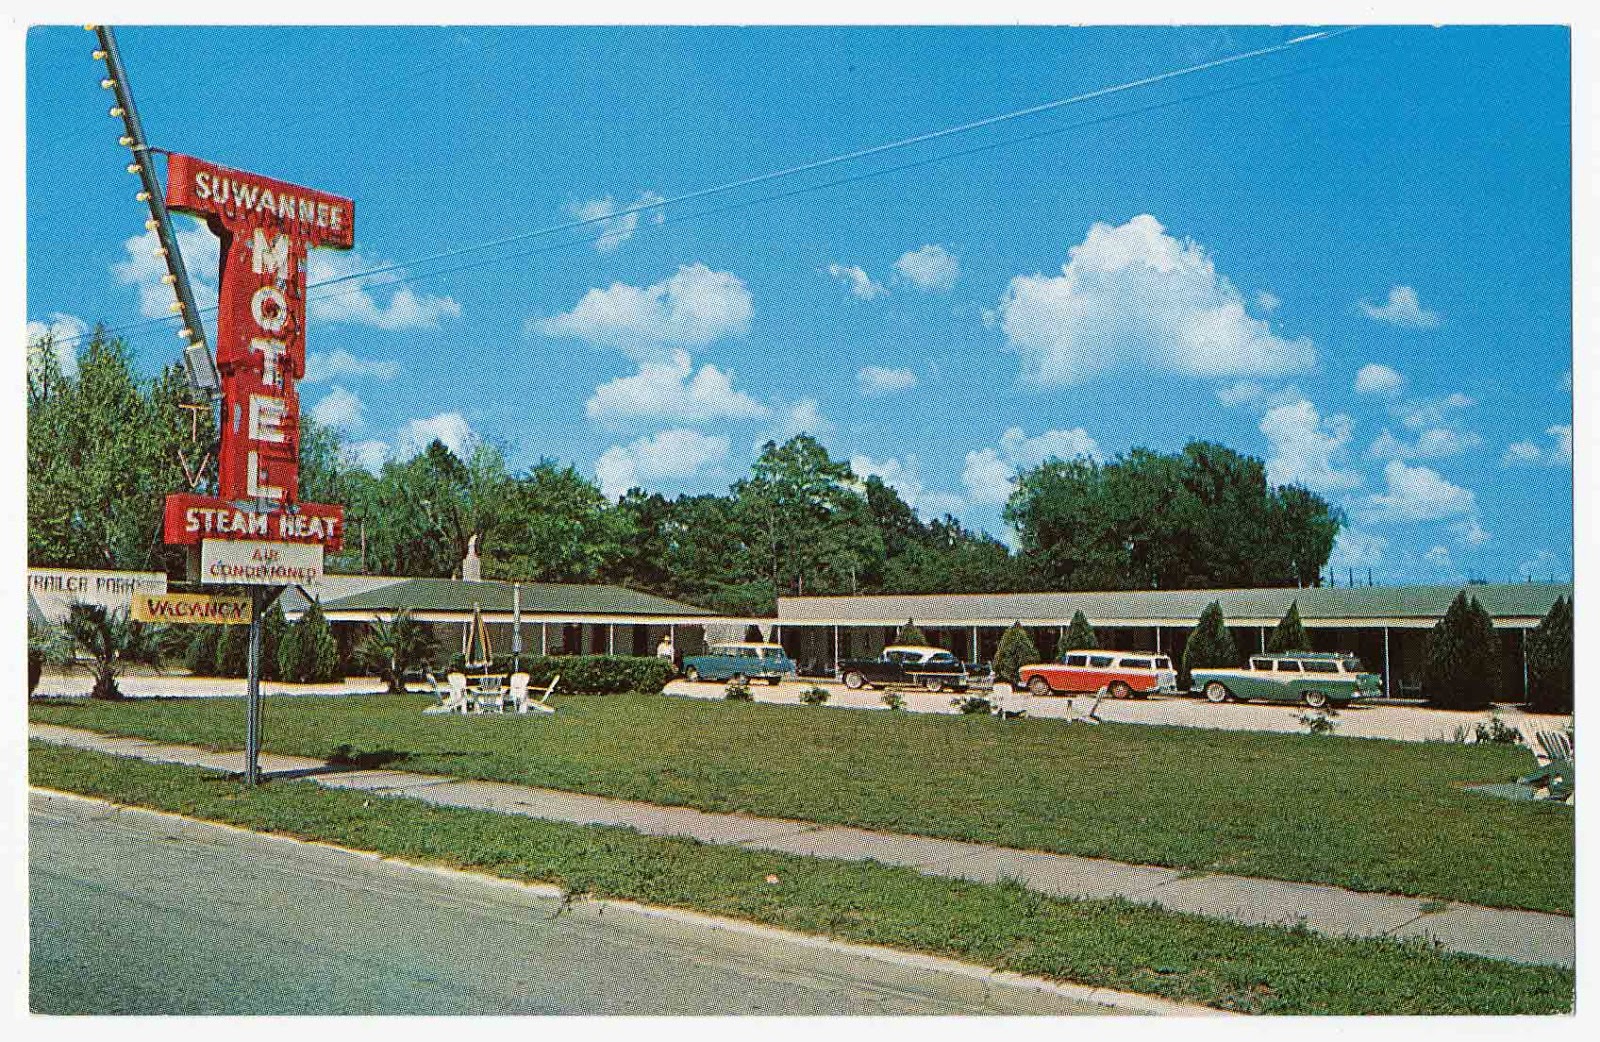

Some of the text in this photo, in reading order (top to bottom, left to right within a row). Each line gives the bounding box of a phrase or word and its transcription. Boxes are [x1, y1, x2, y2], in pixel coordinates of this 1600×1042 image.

[195, 171, 345, 231] SUWANNEE
[247, 227, 290, 499] MOTEL
[185, 509, 338, 540] STEAM HEAT
[252, 549, 279, 560] AIR
[210, 564, 317, 579] CONDITIONED
[147, 599, 247, 619] VACANCY
